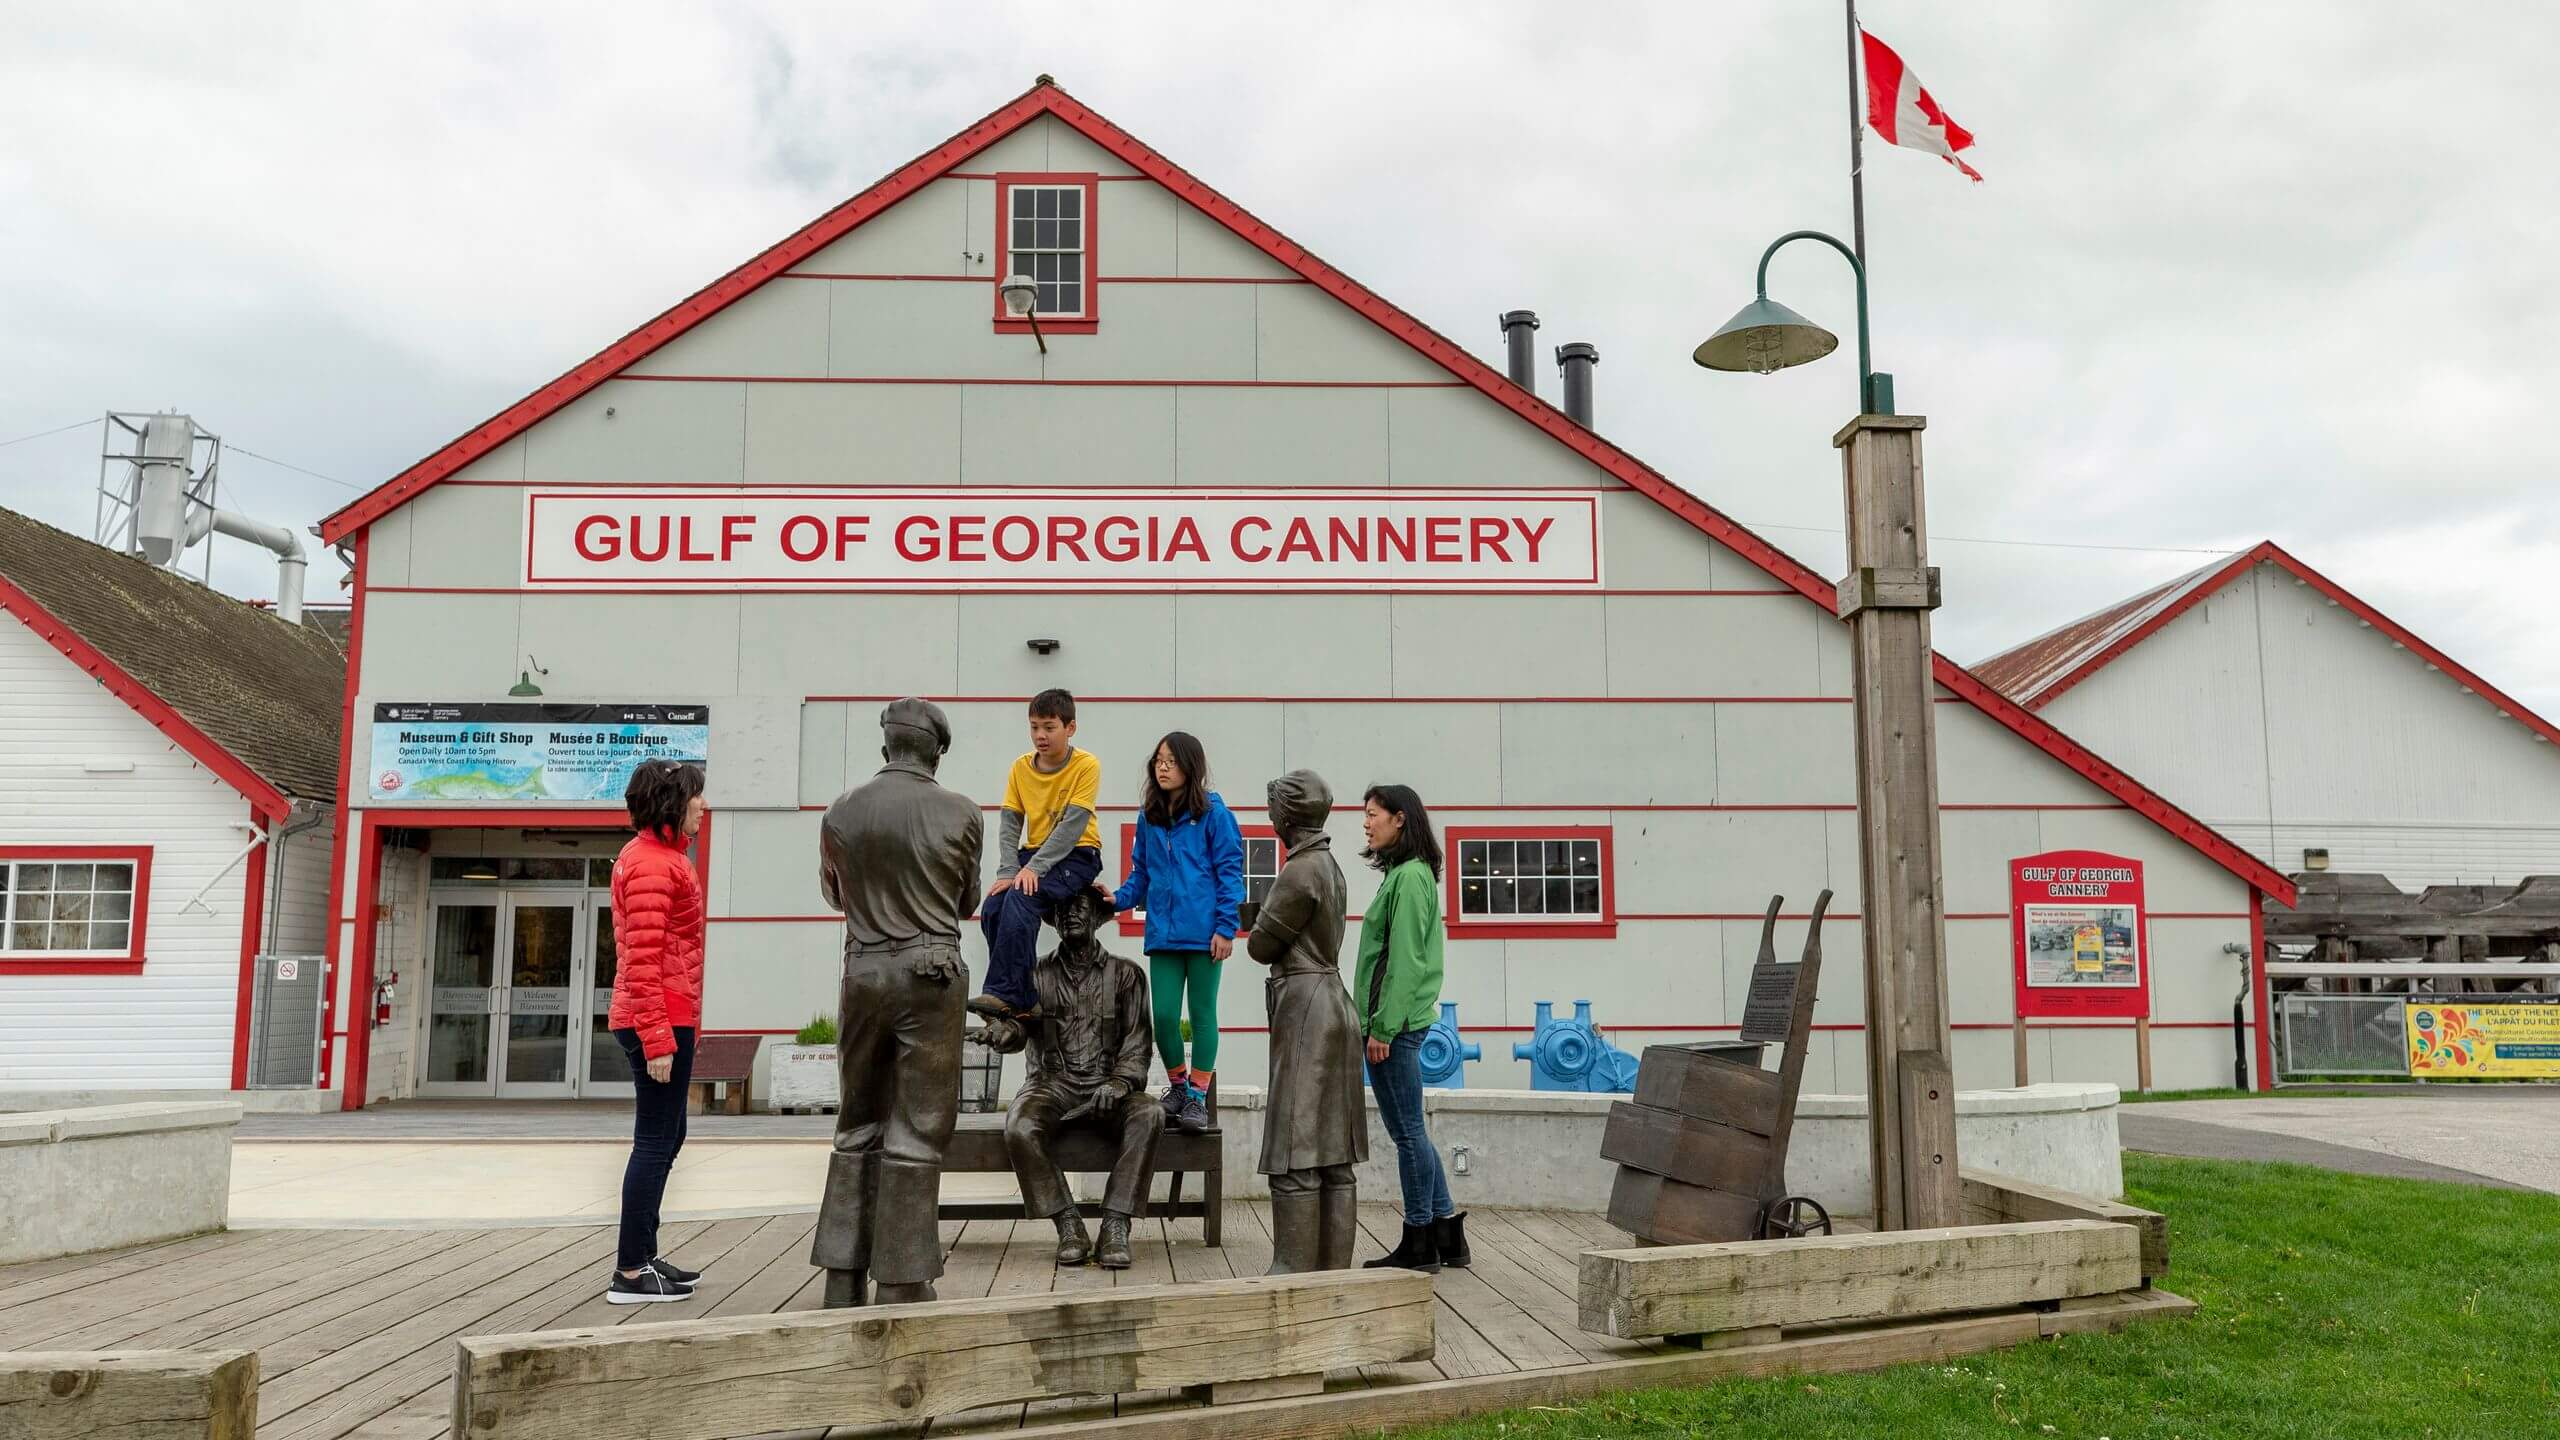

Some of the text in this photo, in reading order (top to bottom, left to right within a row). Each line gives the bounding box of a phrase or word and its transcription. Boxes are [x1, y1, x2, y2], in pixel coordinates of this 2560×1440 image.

[575, 515, 1553, 563] GULF OF GEORGIA CANNERY
[400, 732, 533, 746] Museum & Gift Shop
[549, 732, 668, 747] Musée & Boutique
[399, 747, 420, 756] Open
[421, 747, 442, 756] Daily
[444, 747, 466, 755] 10am
[479, 747, 497, 756] 5pm
[548, 748, 576, 756] Ouvert
[578, 748, 595, 756] tous
[596, 748, 609, 756] les
[610, 748, 631, 757] jours
[632, 748, 642, 756] de
[643, 748, 658, 756] 10h
[668, 749, 684, 757] 17h
[398, 757, 427, 765] Canada's
[466, 758, 490, 766] Fishing
[492, 758, 517, 766] History
[2023, 868, 2133, 881] GULF OF GEORGIA
[2049, 884, 2108, 896] CANNERY
[441, 990, 487, 1000] Bienvenue
[523, 991, 558, 999] Welcome
[519, 1002, 560, 1011] Bienvenue
[2467, 1008, 2559, 1017] THE PULL OF THE NET
